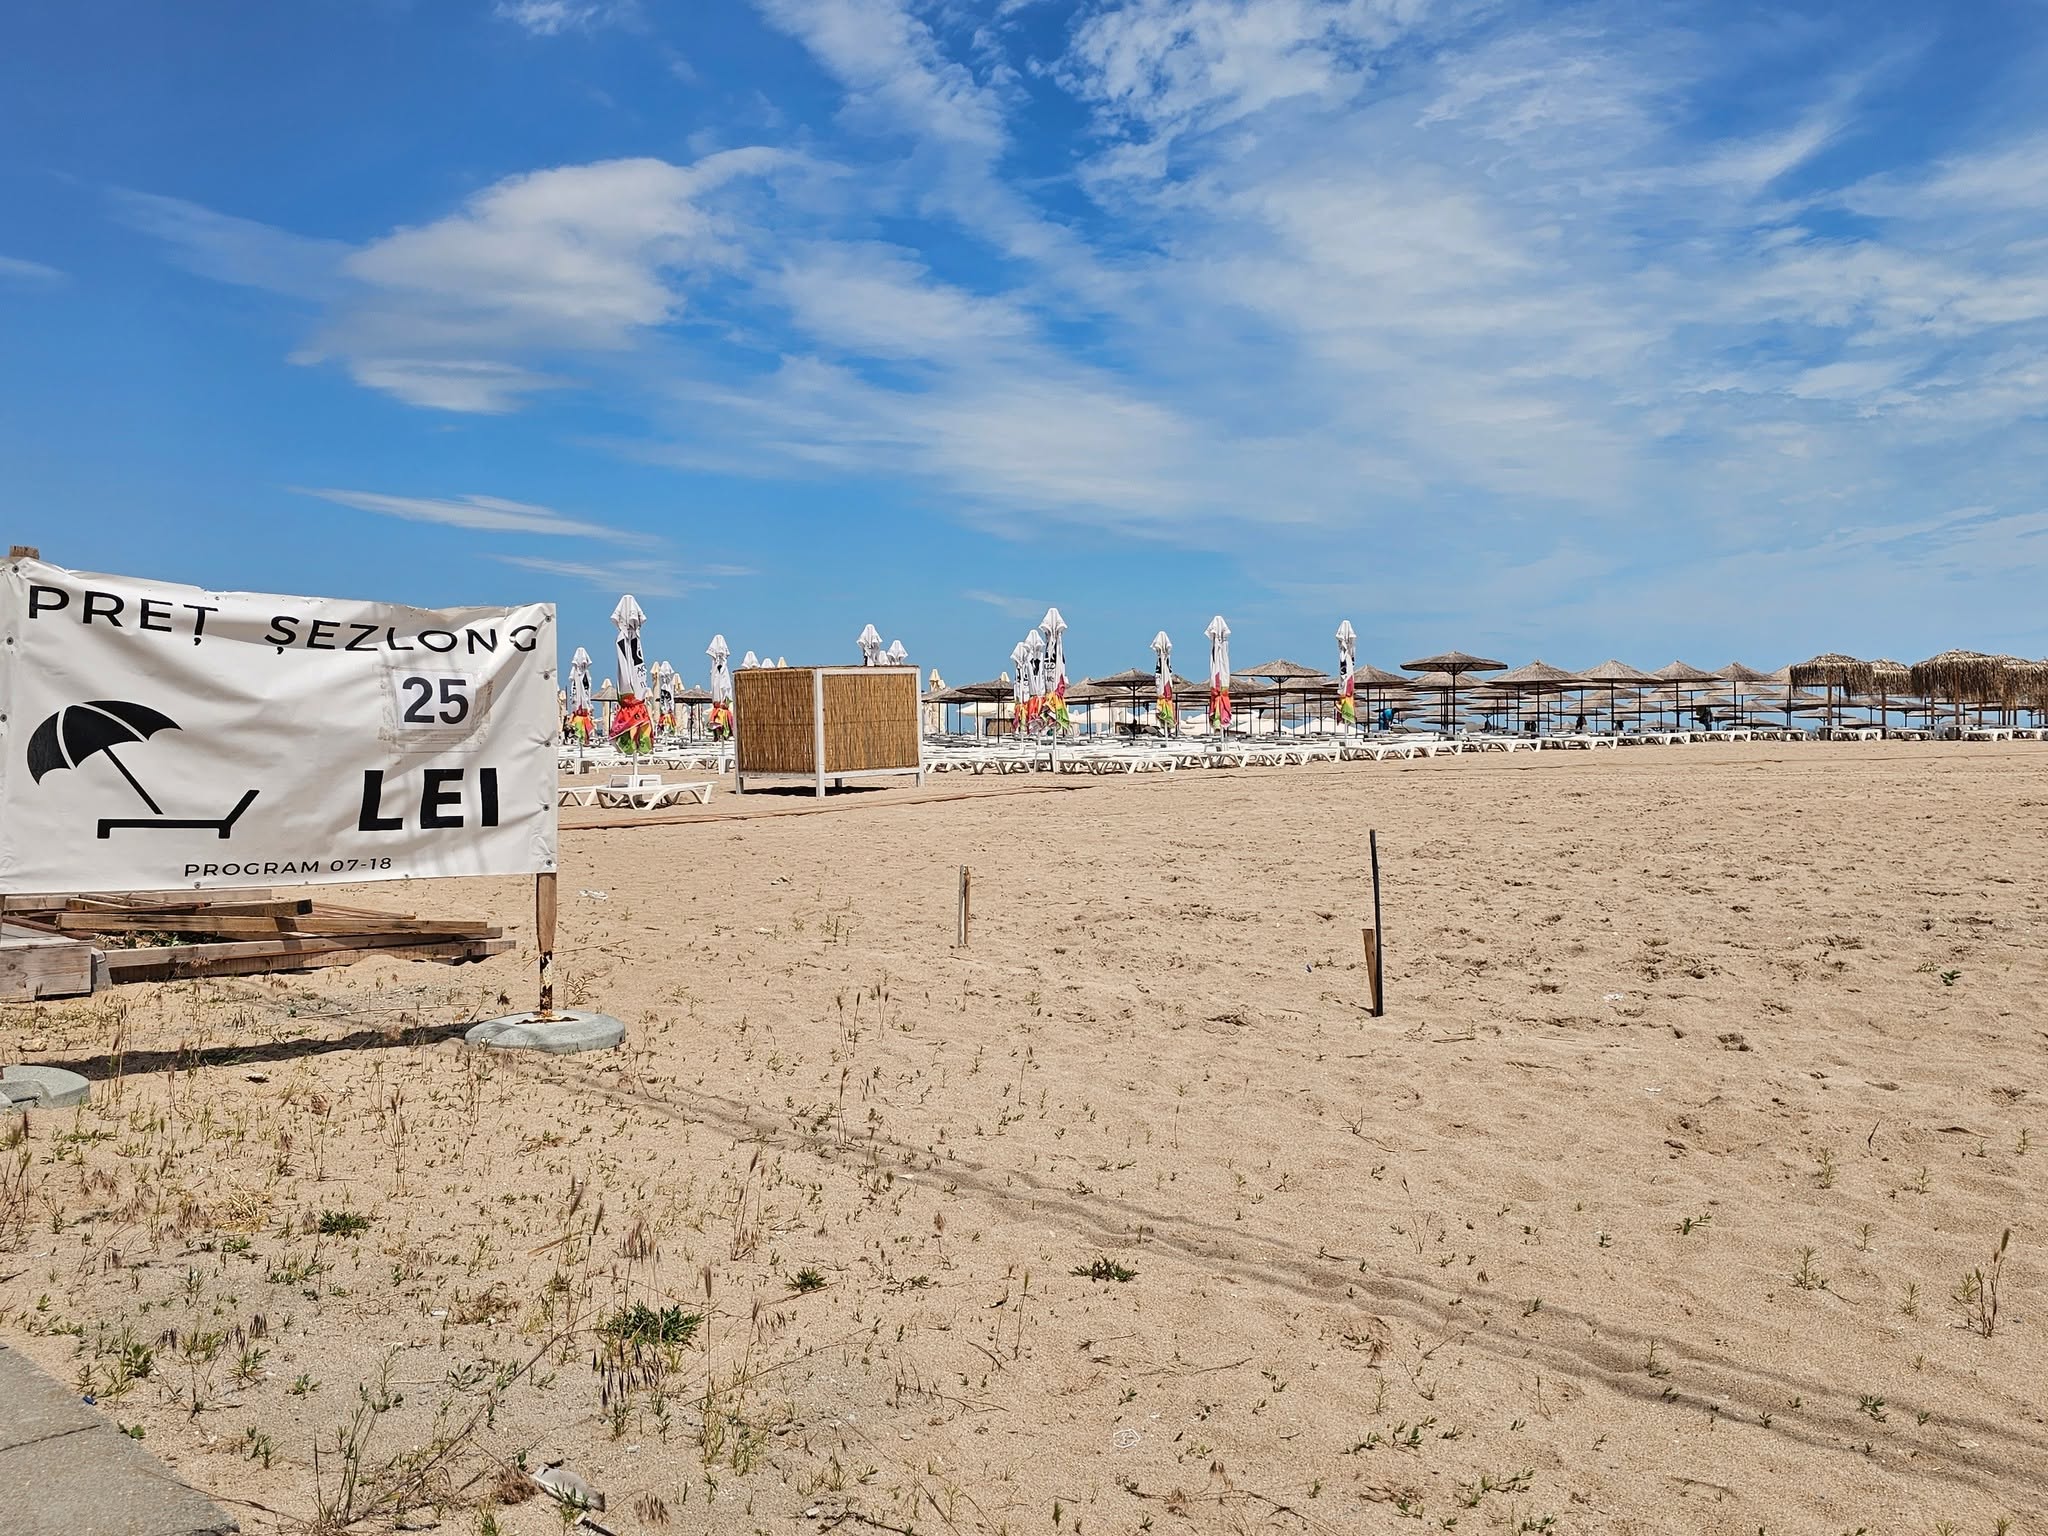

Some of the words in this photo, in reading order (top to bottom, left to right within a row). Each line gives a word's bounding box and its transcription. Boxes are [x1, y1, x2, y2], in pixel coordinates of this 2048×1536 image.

[28, 584, 219, 646] PREȚ
[264, 615, 538, 655] ȘEZLONG
[402, 676, 469, 724] 25
[358, 767, 499, 831] LEI
[184, 860, 320, 877] PROGRAM
[330, 857, 392, 873] 07-18
